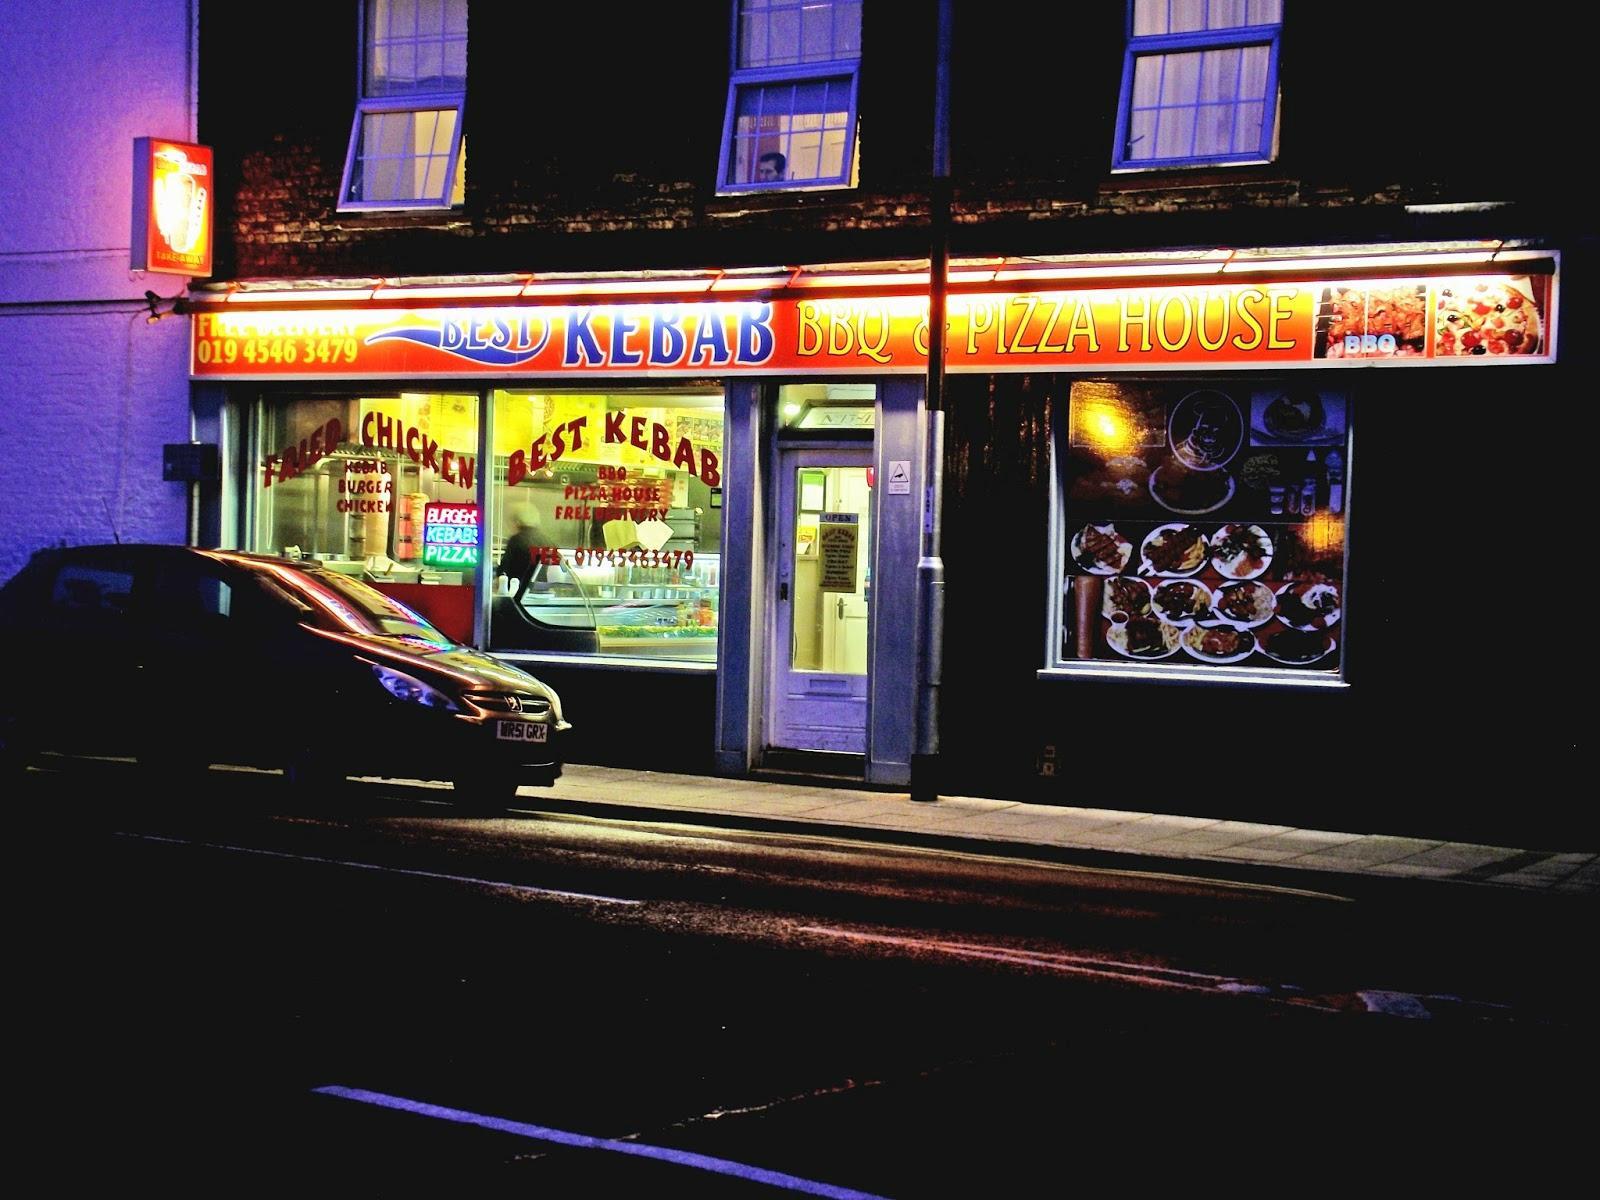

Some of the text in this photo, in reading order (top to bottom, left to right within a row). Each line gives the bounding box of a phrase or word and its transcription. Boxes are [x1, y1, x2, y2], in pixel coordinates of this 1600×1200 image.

[437, 301, 775, 367] BEST KEBAB
[796, 299, 892, 364] BBQ
[966, 295, 1100, 355] PIZZA
[1117, 288, 1299, 353] HOUSE
[198, 337, 358, 363] 019 4546 3479
[1343, 334, 1396, 354] BBQ
[361, 411, 475, 489] CHICKEN
[508, 410, 720, 487] BEST KEBAB
[598, 465, 627, 480] BBQ
[338, 480, 393, 494] BURGER
[564, 485, 661, 502] PIZZA HOUSE
[336, 500, 393, 513] CHICKEN
[555, 506, 592, 520] FREE
[825, 513, 852, 523] OPEN
[526, 724, 546, 740] GRX
